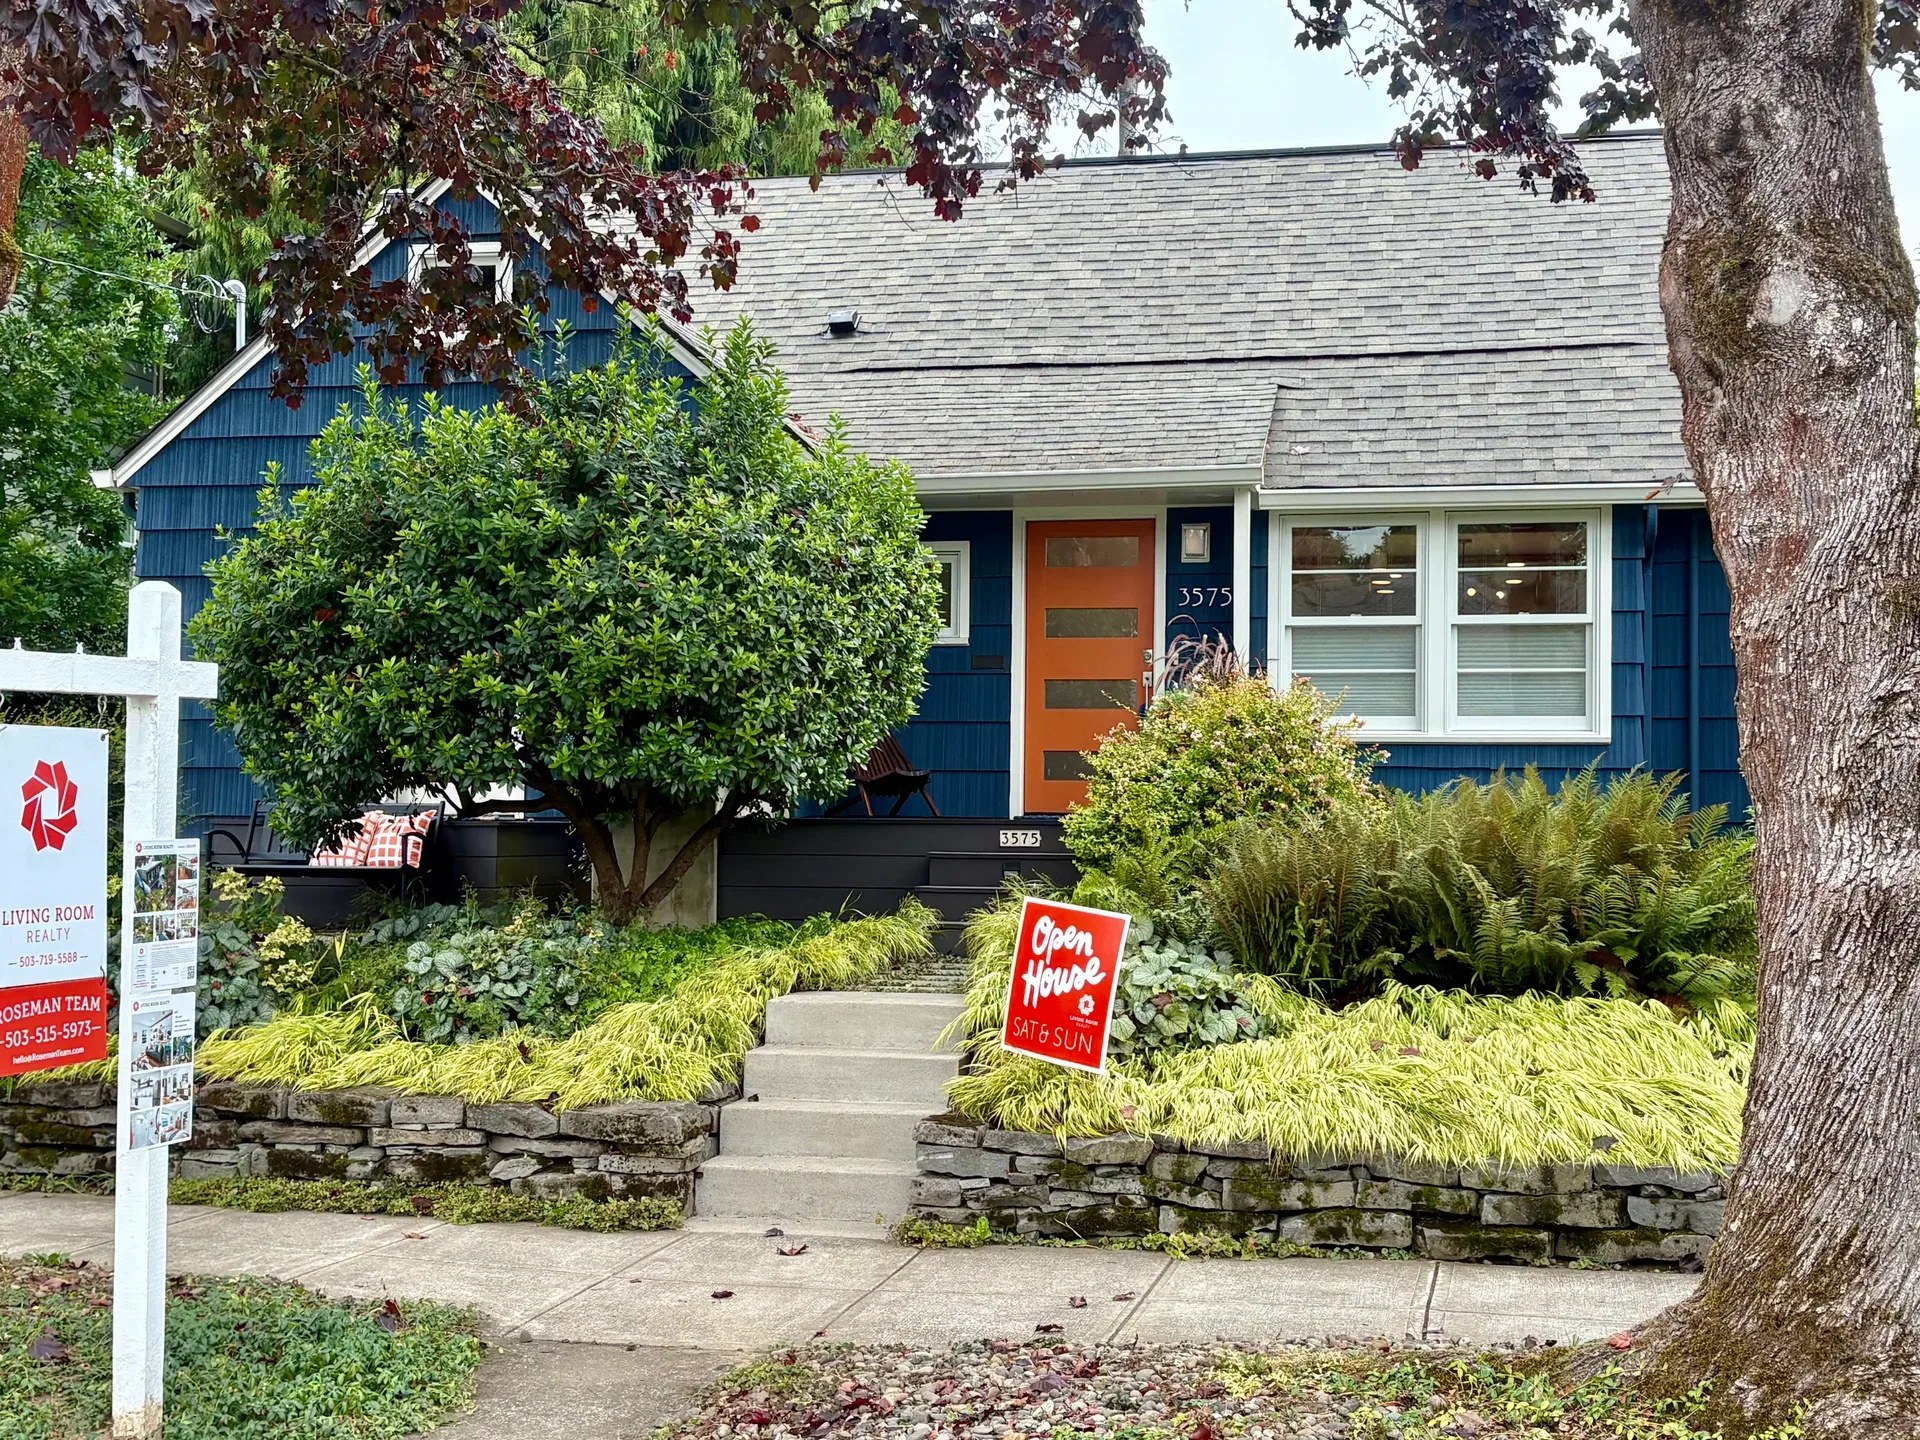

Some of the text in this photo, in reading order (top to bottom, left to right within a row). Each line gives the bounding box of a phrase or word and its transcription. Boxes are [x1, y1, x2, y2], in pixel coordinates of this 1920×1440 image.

[1178, 587, 1232, 607] 3575
[1001, 832, 1039, 845] 3575
[2, 905, 95, 926] LIVING ROOM
[26, 927, 71, 944] REALTY
[1031, 915, 1094, 966] Open
[19, 951, 78, 968] 503-719-5588
[1021, 956, 1107, 1009] House
[65, 995, 101, 1012] TEAM
[1012, 1016, 1093, 1055] SAT & SUN
